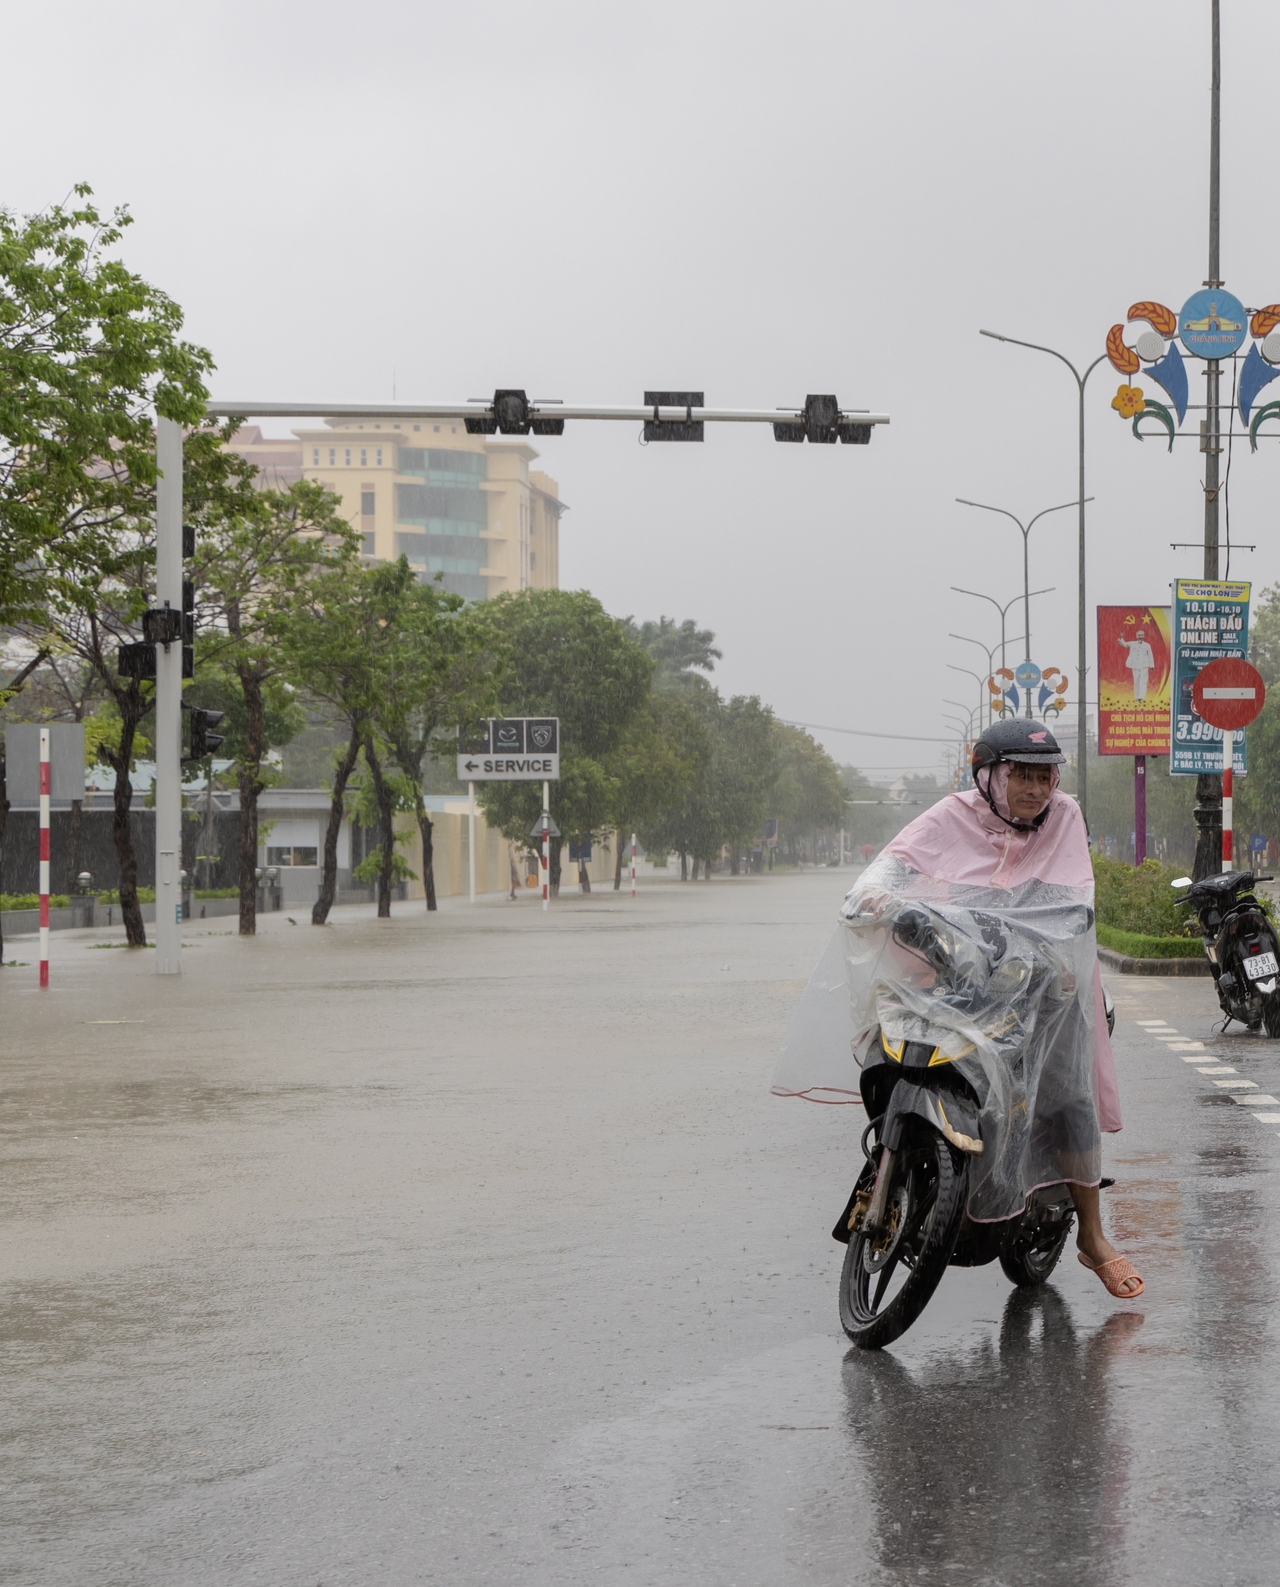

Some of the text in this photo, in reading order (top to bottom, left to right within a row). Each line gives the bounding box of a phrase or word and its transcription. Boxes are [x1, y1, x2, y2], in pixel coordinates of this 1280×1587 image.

[1190, 333, 1236, 342] QUẢNG BÌNH
[1185, 602, 1215, 613] 10.10
[1180, 614, 1243, 630] THÁCH ĐẤU
[1180, 632, 1218, 644] ONLINE
[1181, 648, 1242, 658] TỦ LẠNH NHẬT BẢN
[1123, 714, 1135, 723] TỊCH
[1116, 726, 1125, 736] ĐẠI
[1126, 724, 1141, 734] SỐNG
[1135, 737, 1146, 747] CỦA
[1175, 751, 1192, 759] 559B
[1194, 751, 1201, 759] LÝ
[484, 760, 552, 772] SERVICE
[1180, 760, 1193, 768] BẮC
[1248, 956, 1270, 968] 73-B1
[1249, 963, 1276, 977] 433.30
